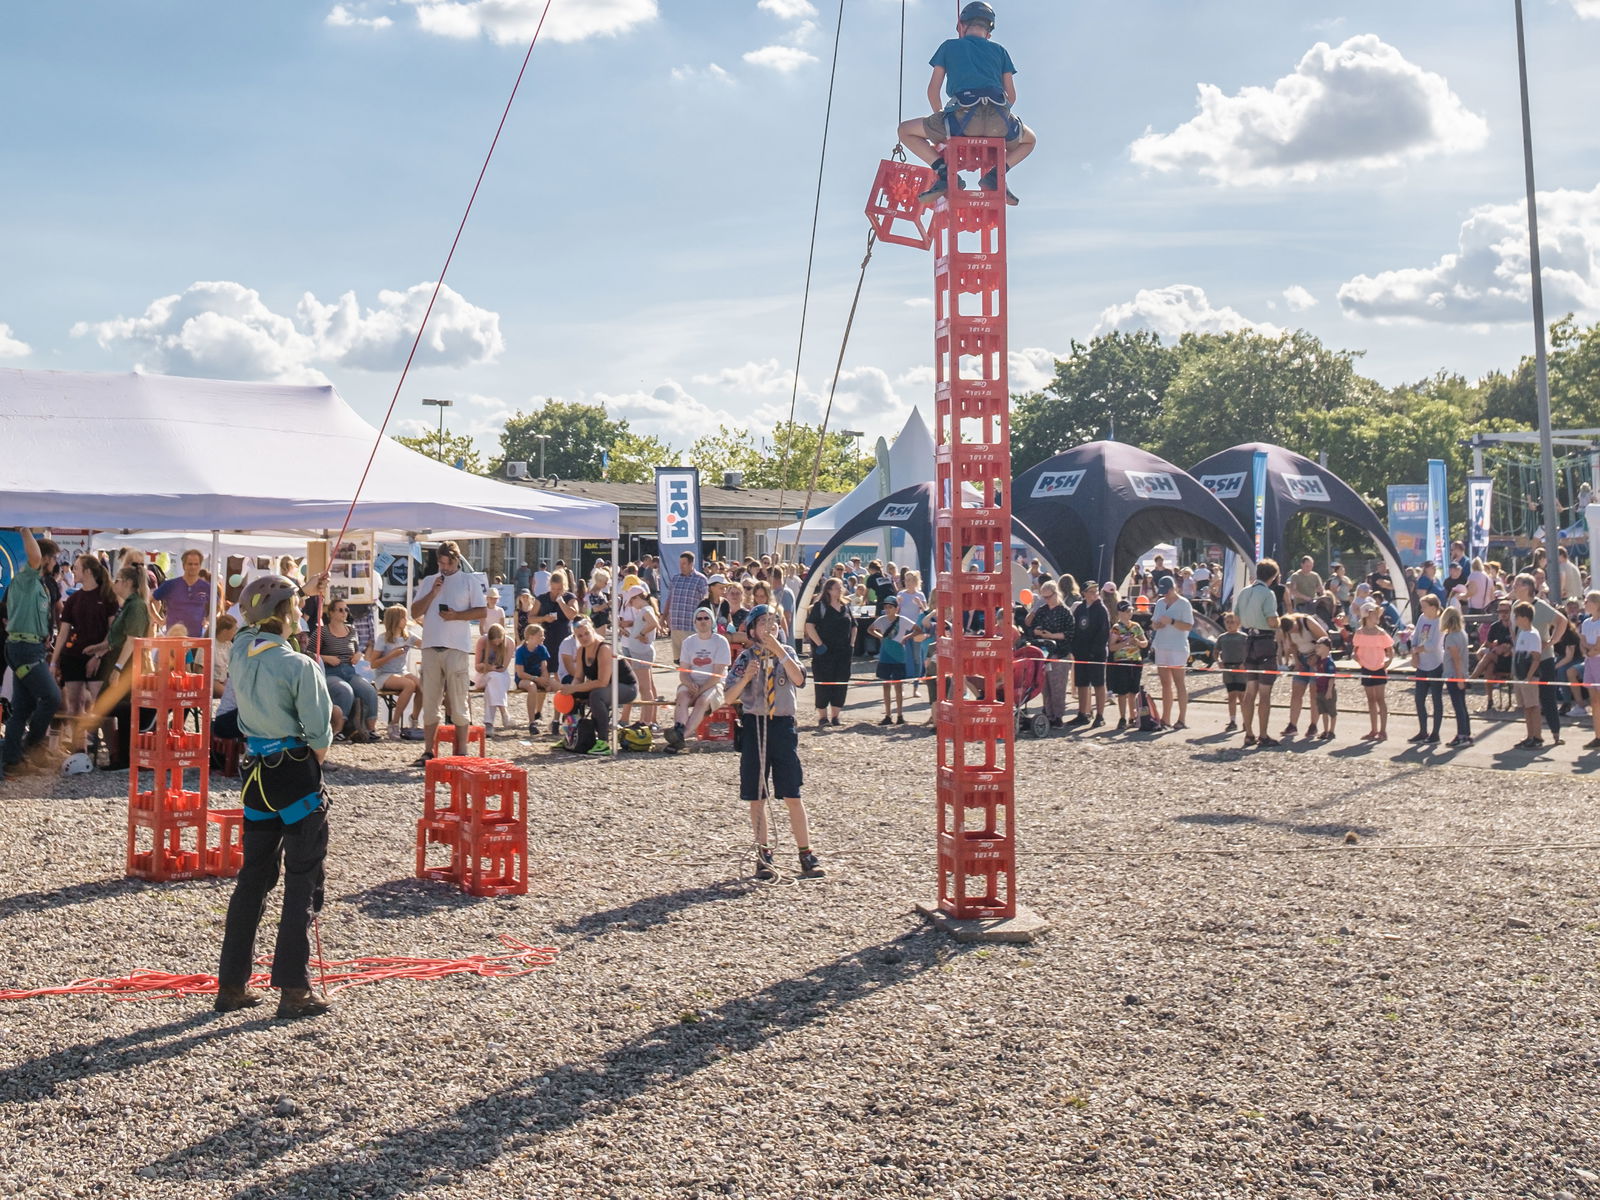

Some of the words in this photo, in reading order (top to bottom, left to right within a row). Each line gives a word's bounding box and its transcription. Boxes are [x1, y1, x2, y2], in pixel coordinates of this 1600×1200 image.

[1038, 474, 1080, 489] RSH
[1131, 476, 1174, 490] RSH
[1203, 477, 1242, 491] RSH
[1288, 479, 1322, 492] RSH
[884, 506, 914, 515] RSH
[1475, 489, 1484, 540] RSH
